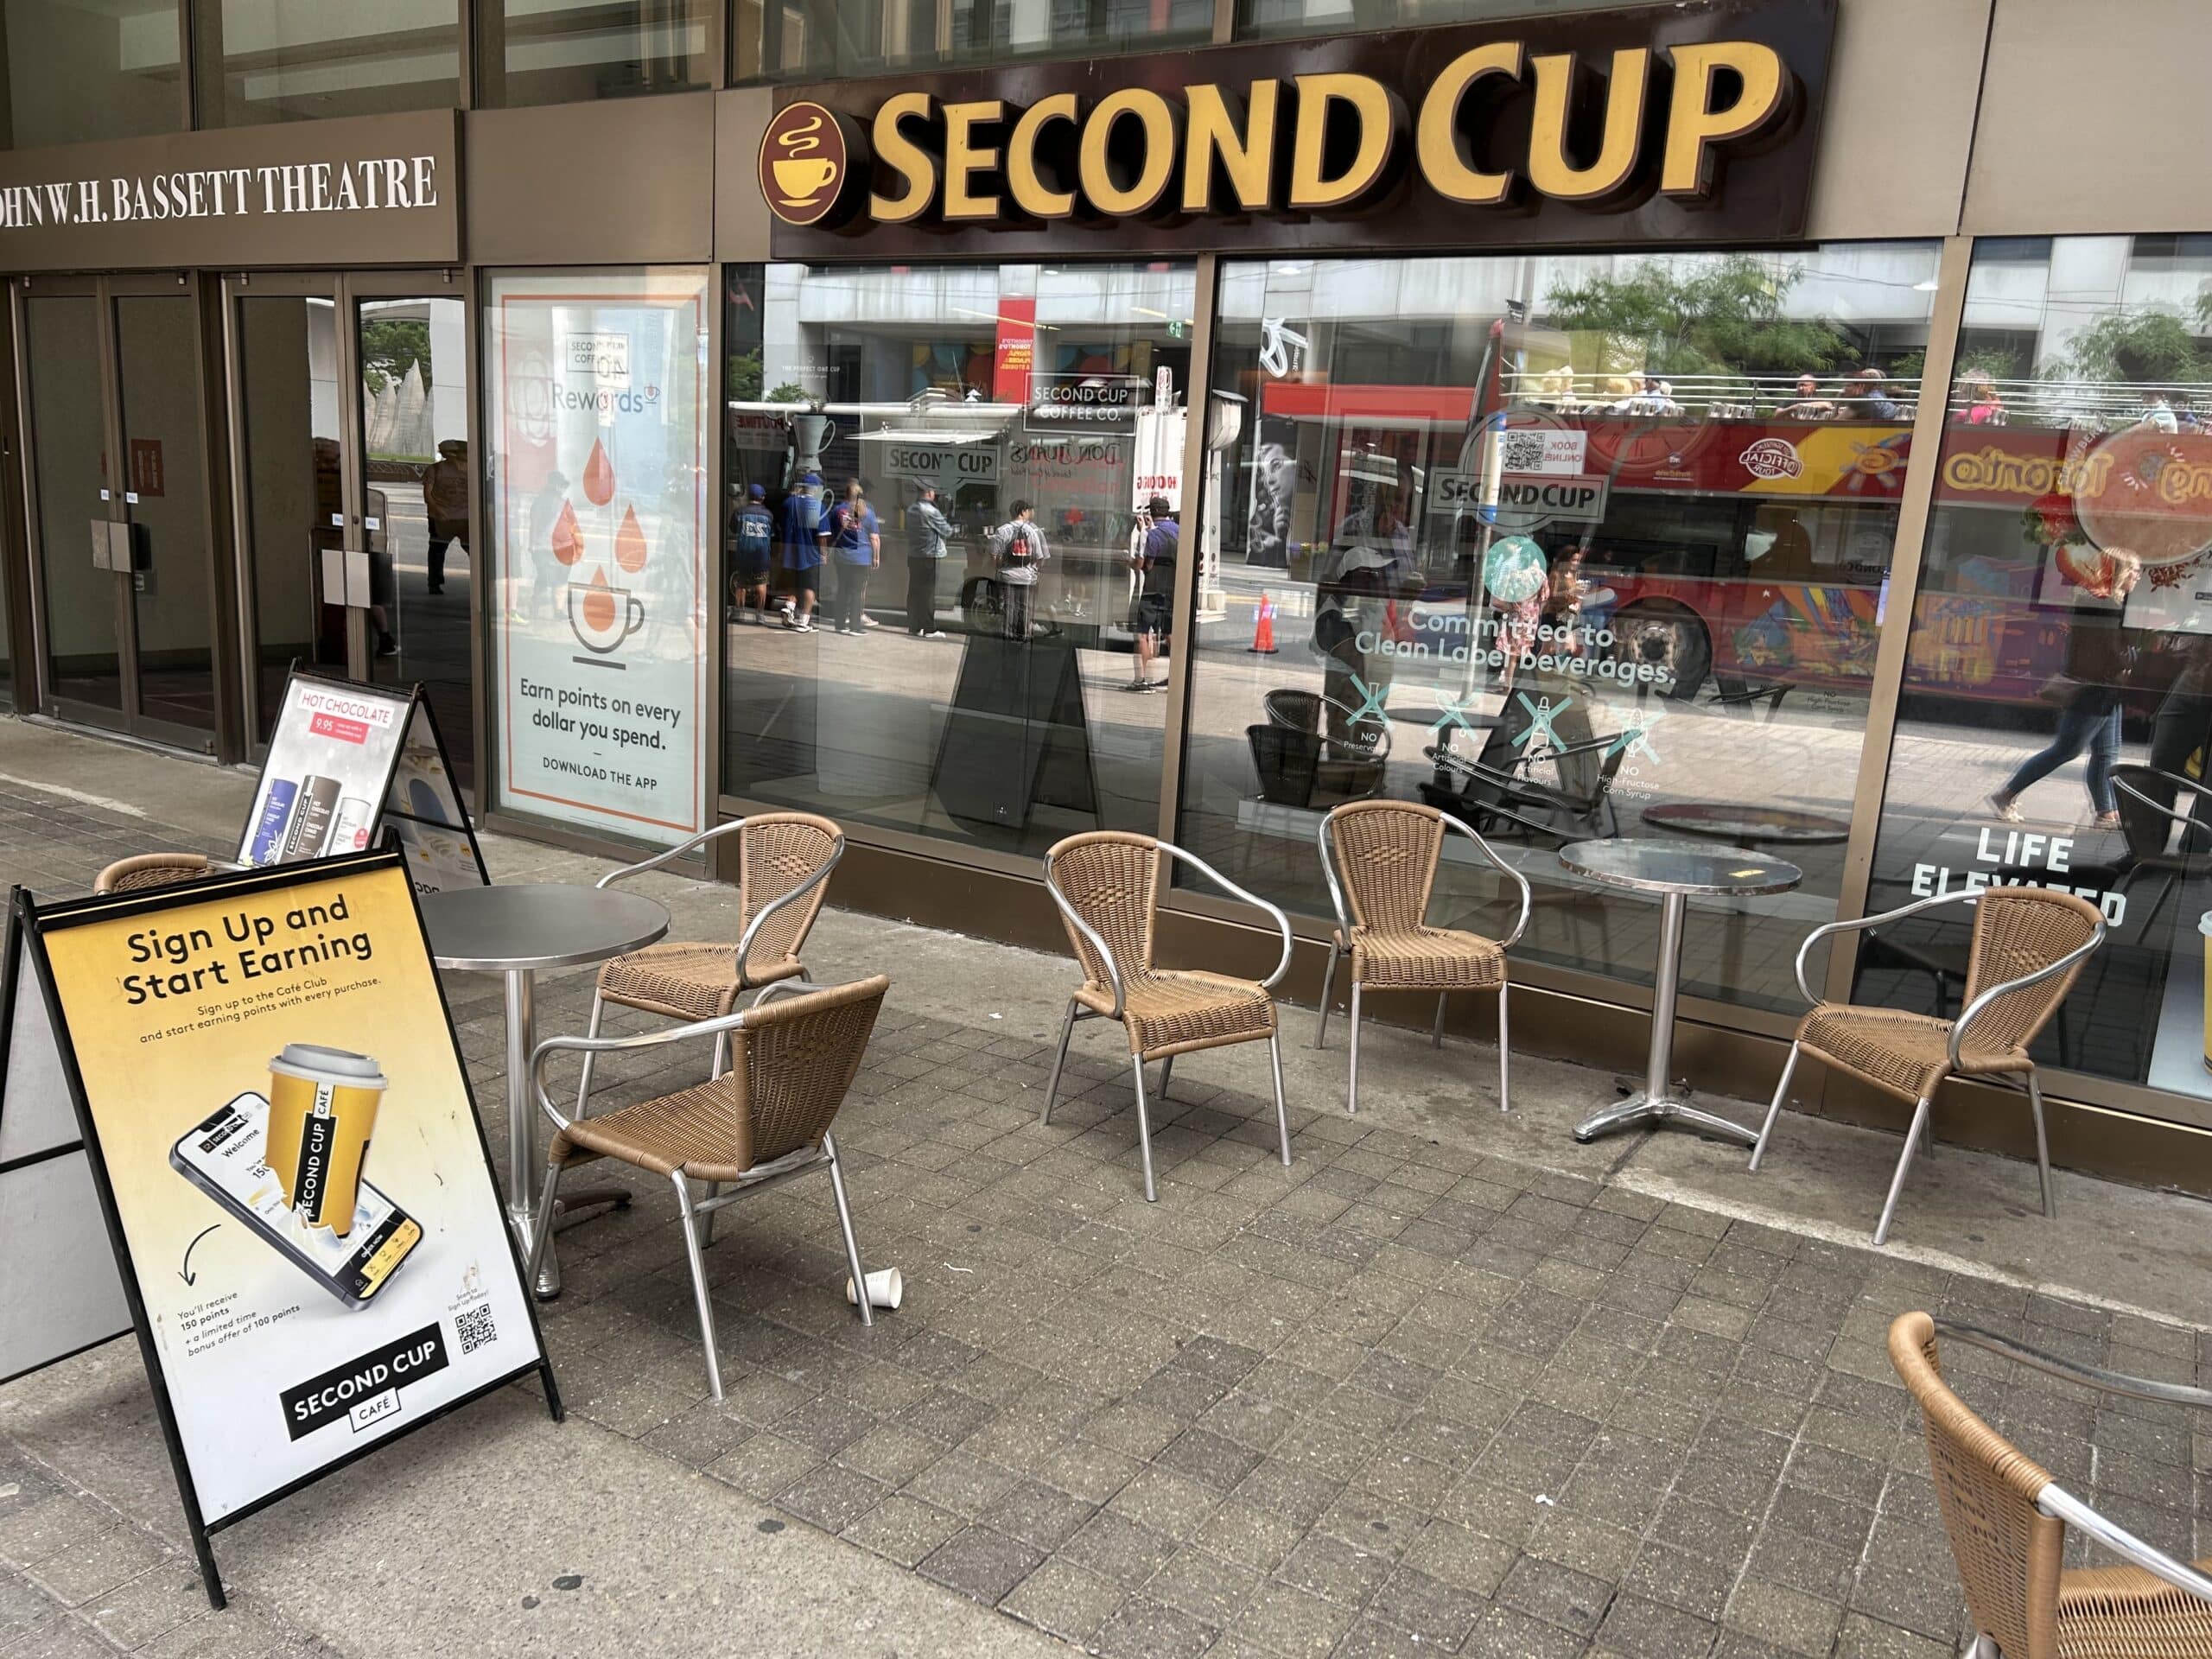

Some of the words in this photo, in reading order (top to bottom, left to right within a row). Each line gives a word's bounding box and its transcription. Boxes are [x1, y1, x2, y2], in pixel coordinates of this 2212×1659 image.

[870, 73, 1395, 222] SECOND
[1416, 41, 1783, 205] CUP
[46, 180, 107, 225] W.H.
[111, 169, 251, 221] BASSETT
[257, 156, 437, 213] THEATRE
[552, 383, 644, 413] Rewards
[1034, 387, 1094, 402] SECOND
[1097, 389, 1128, 404] CUP
[1040, 404, 1092, 421] COFFEE
[1096, 407, 1122, 422] CO.
[889, 448, 955, 470] SECON
[957, 453, 993, 473] CUP
[1440, 478, 1539, 505] SECND
[1542, 484, 1596, 508] CUP
[1408, 606, 1575, 644] Committed
[1580, 622, 1614, 648] to
[1355, 631, 1428, 659] Clean
[1438, 639, 1510, 668] Label
[1519, 643, 1677, 688] beverages.
[302, 692, 326, 708] HOT
[325, 698, 391, 724] CHOCOLATE
[520, 677, 554, 701] Earn
[558, 687, 607, 710] points
[612, 698, 631, 715] on
[635, 703, 681, 728] every
[532, 709, 575, 733] dollar
[579, 721, 608, 741] you
[612, 727, 667, 750] spend.
[1361, 732, 1377, 742] NO
[1441, 742, 1459, 753] NO
[1528, 754, 1546, 764] NO
[543, 757, 607, 780] DOWNLOAD
[610, 771, 632, 786] THE
[635, 777, 658, 791] APP
[1433, 762, 1464, 774] Colours
[1516, 774, 1552, 786] Flavours
[1517, 765, 1554, 775] Artificial
[1597, 774, 1660, 791] High-Fructose
[1620, 766, 1639, 776] NO
[1602, 786, 1624, 796] Corn
[1626, 788, 1651, 801] Syrup
[289, 815, 302, 851] SECOND
[300, 798, 308, 815] CUP
[1976, 827, 2074, 873] LIFE
[1910, 863, 2127, 927] ELED
[127, 927, 213, 964] Sign
[222, 912, 275, 946] Up
[286, 893, 350, 930] and
[123, 960, 229, 1005] Start
[238, 932, 373, 979] Earning
[139, 1029, 162, 1044] and
[165, 1022, 194, 1037] start
[197, 1012, 241, 1030] earning
[243, 1002, 277, 1020] points
[278, 995, 302, 1008] with
[304, 988, 332, 1003] every
[334, 977, 382, 996] purchase.
[197, 1002, 222, 1017] Sign
[225, 998, 239, 1011] up
[241, 995, 254, 1006] to
[256, 990, 275, 1002] the
[276, 983, 302, 998] Café
[302, 977, 328, 990] Club
[317, 1090, 329, 1115] CAFÉ
[221, 1128, 260, 1158] Welcome
[311, 1122, 326, 1154] CUP
[177, 1304, 204, 1320] You'll
[206, 1292, 238, 1309] receive
[181, 1319, 198, 1332] 150
[200, 1306, 230, 1326] points
[188, 1340, 216, 1357] bonus
[218, 1330, 241, 1344] offer
[243, 1324, 252, 1334] of
[254, 1316, 270, 1328] 100
[271, 1305, 301, 1323] points
[201, 1319, 233, 1339] limited
[236, 1310, 257, 1325] time
[294, 1363, 389, 1421] SECOND
[392, 1340, 435, 1373] CUP
[359, 1396, 391, 1421] CAFÉ
